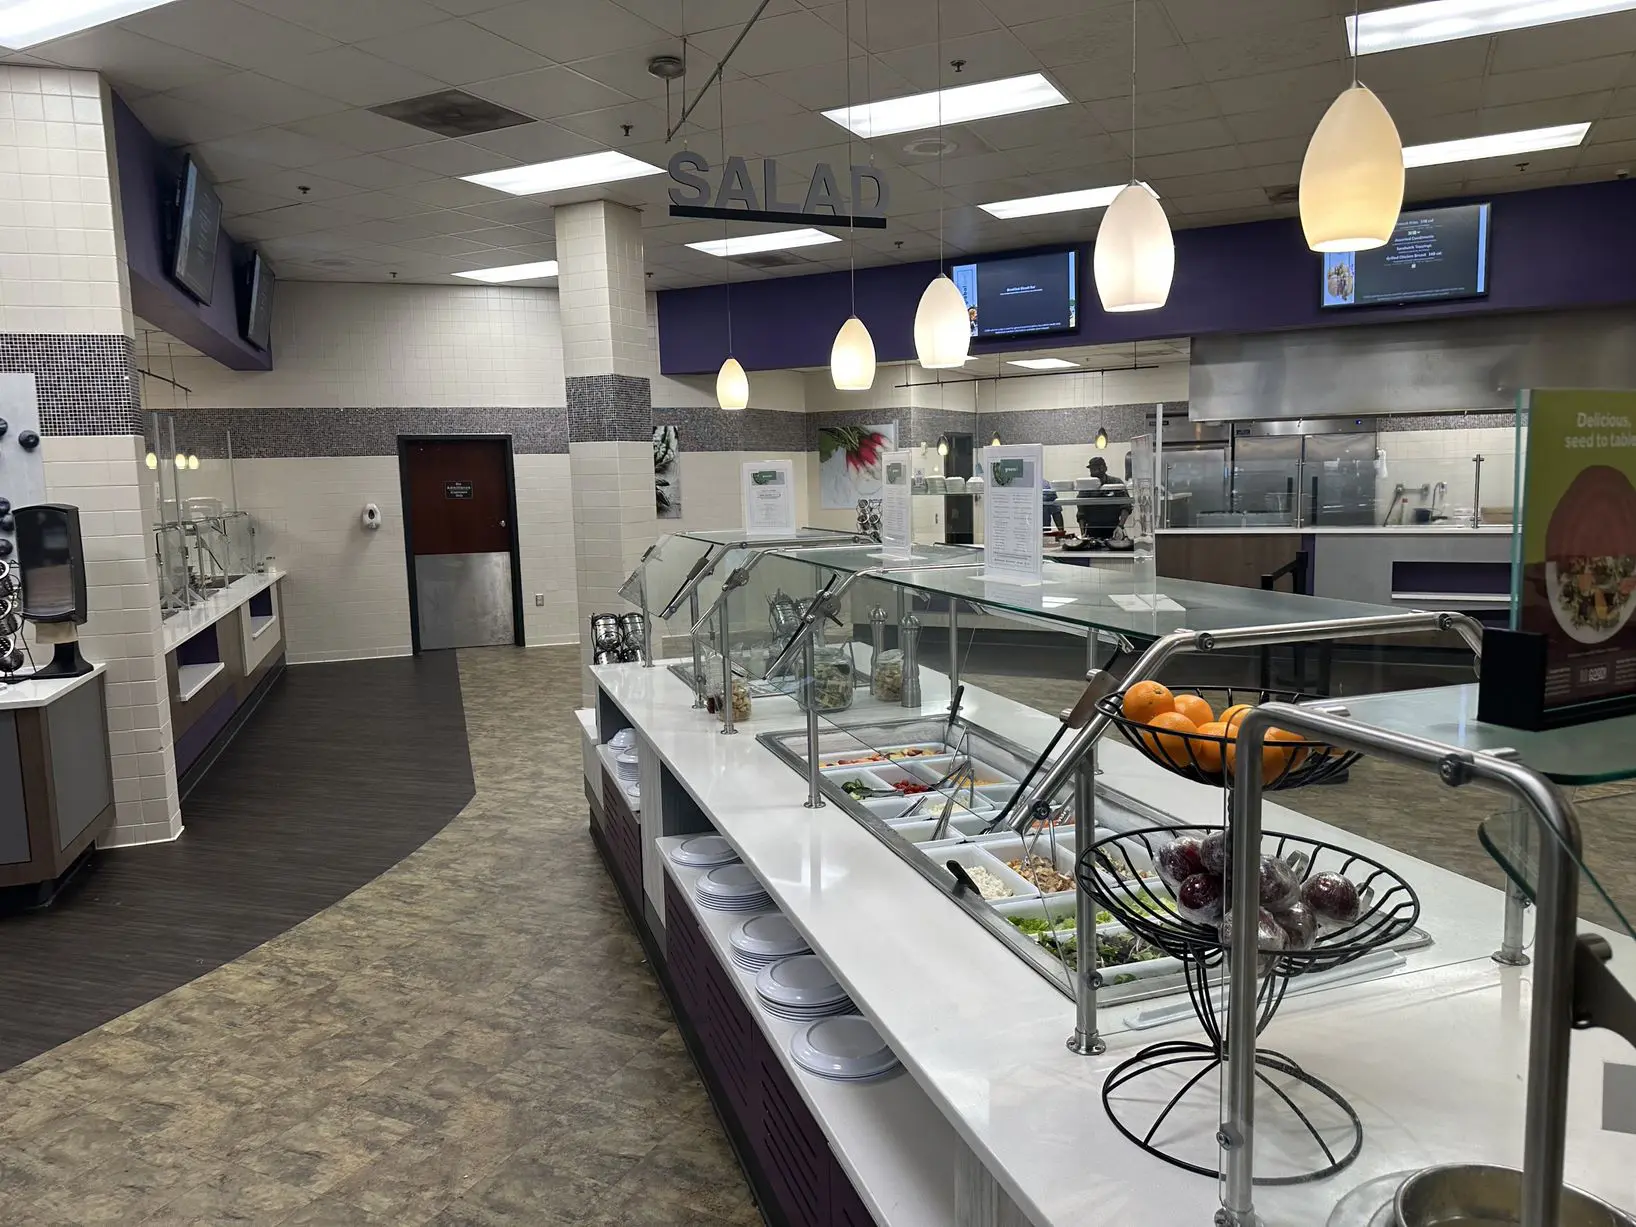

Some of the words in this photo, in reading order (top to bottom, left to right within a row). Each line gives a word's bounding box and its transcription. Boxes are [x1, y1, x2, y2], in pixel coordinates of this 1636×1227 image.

[668, 151, 890, 218] SALAD
[1577, 411, 1632, 429] Delicious,
[1564, 432, 1595, 448] seed
[1596, 433, 1608, 448] to
